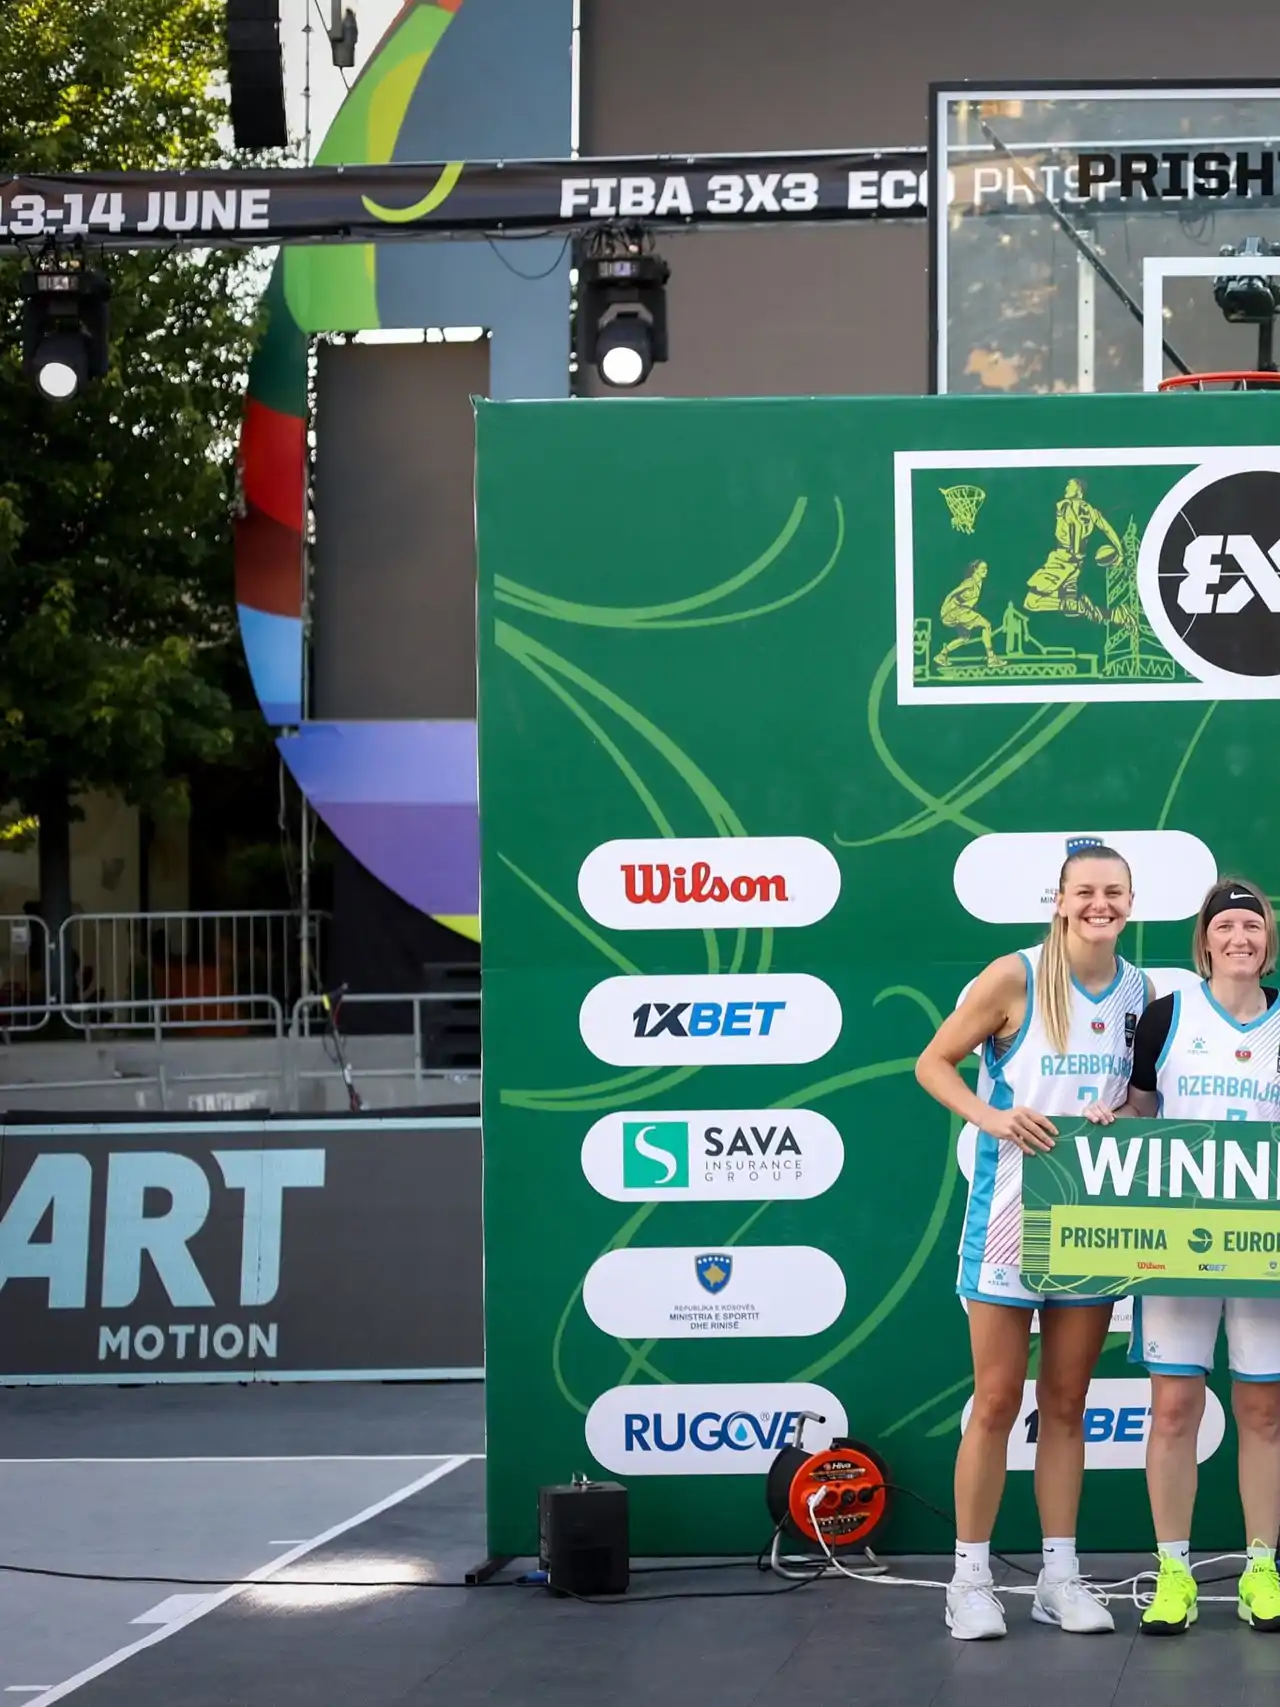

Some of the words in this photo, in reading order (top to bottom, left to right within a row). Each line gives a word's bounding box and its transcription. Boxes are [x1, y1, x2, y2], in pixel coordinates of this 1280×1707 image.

[0, 194, 125, 235] 3-14
[137, 188, 271, 232] JUNE
[560, 176, 694, 218] FIBA
[706, 172, 819, 214] 3X3
[620, 861, 789, 904] Wilson
[633, 1001, 787, 1037] 1XBET
[704, 1126, 803, 1157] SAVA
[704, 1171, 803, 1182] GROUP
[705, 1160, 802, 1171] INSURANCE
[0, 1148, 326, 1309] ART
[1060, 1226, 1168, 1250] PRISHTINA
[669, 1313, 713, 1321] MINISTRIA
[722, 1312, 760, 1320] SPORTIT
[690, 1322, 709, 1330] DHE
[98, 1322, 279, 1360] MOTION
[1025, 1407, 1152, 1443] 1BE
